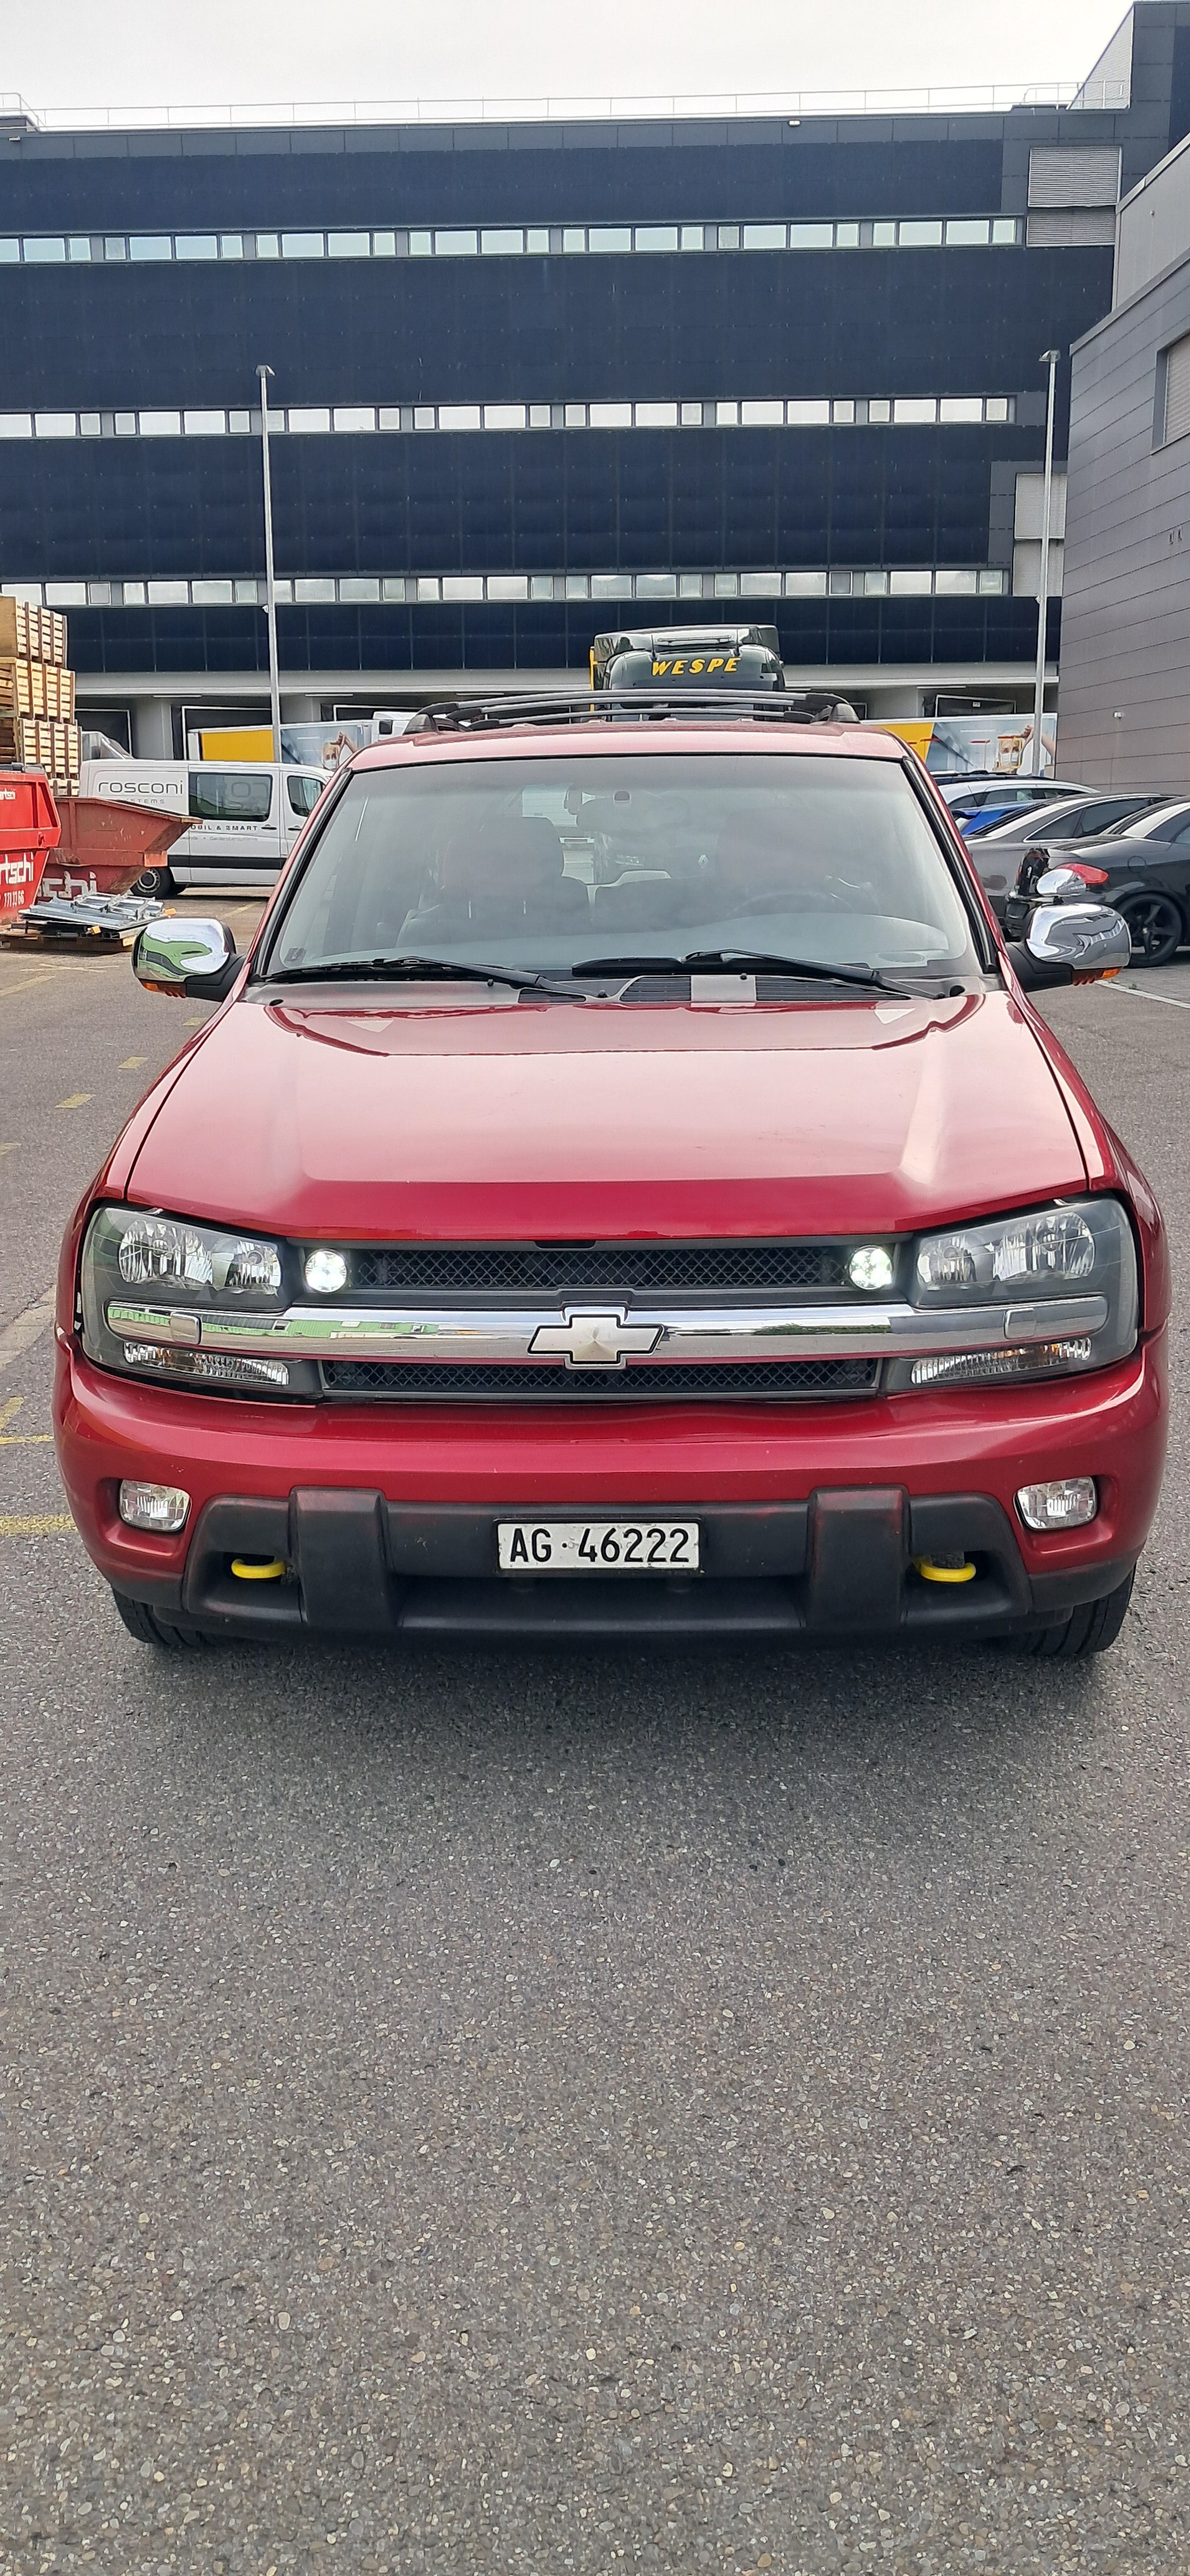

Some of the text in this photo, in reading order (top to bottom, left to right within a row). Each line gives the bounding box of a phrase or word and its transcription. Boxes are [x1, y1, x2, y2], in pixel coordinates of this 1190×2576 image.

[652, 657, 742, 676] WESPE
[98, 780, 183, 795] rosconi
[37, 870, 97, 898] chi
[510, 1527, 690, 1563] AG 46222
